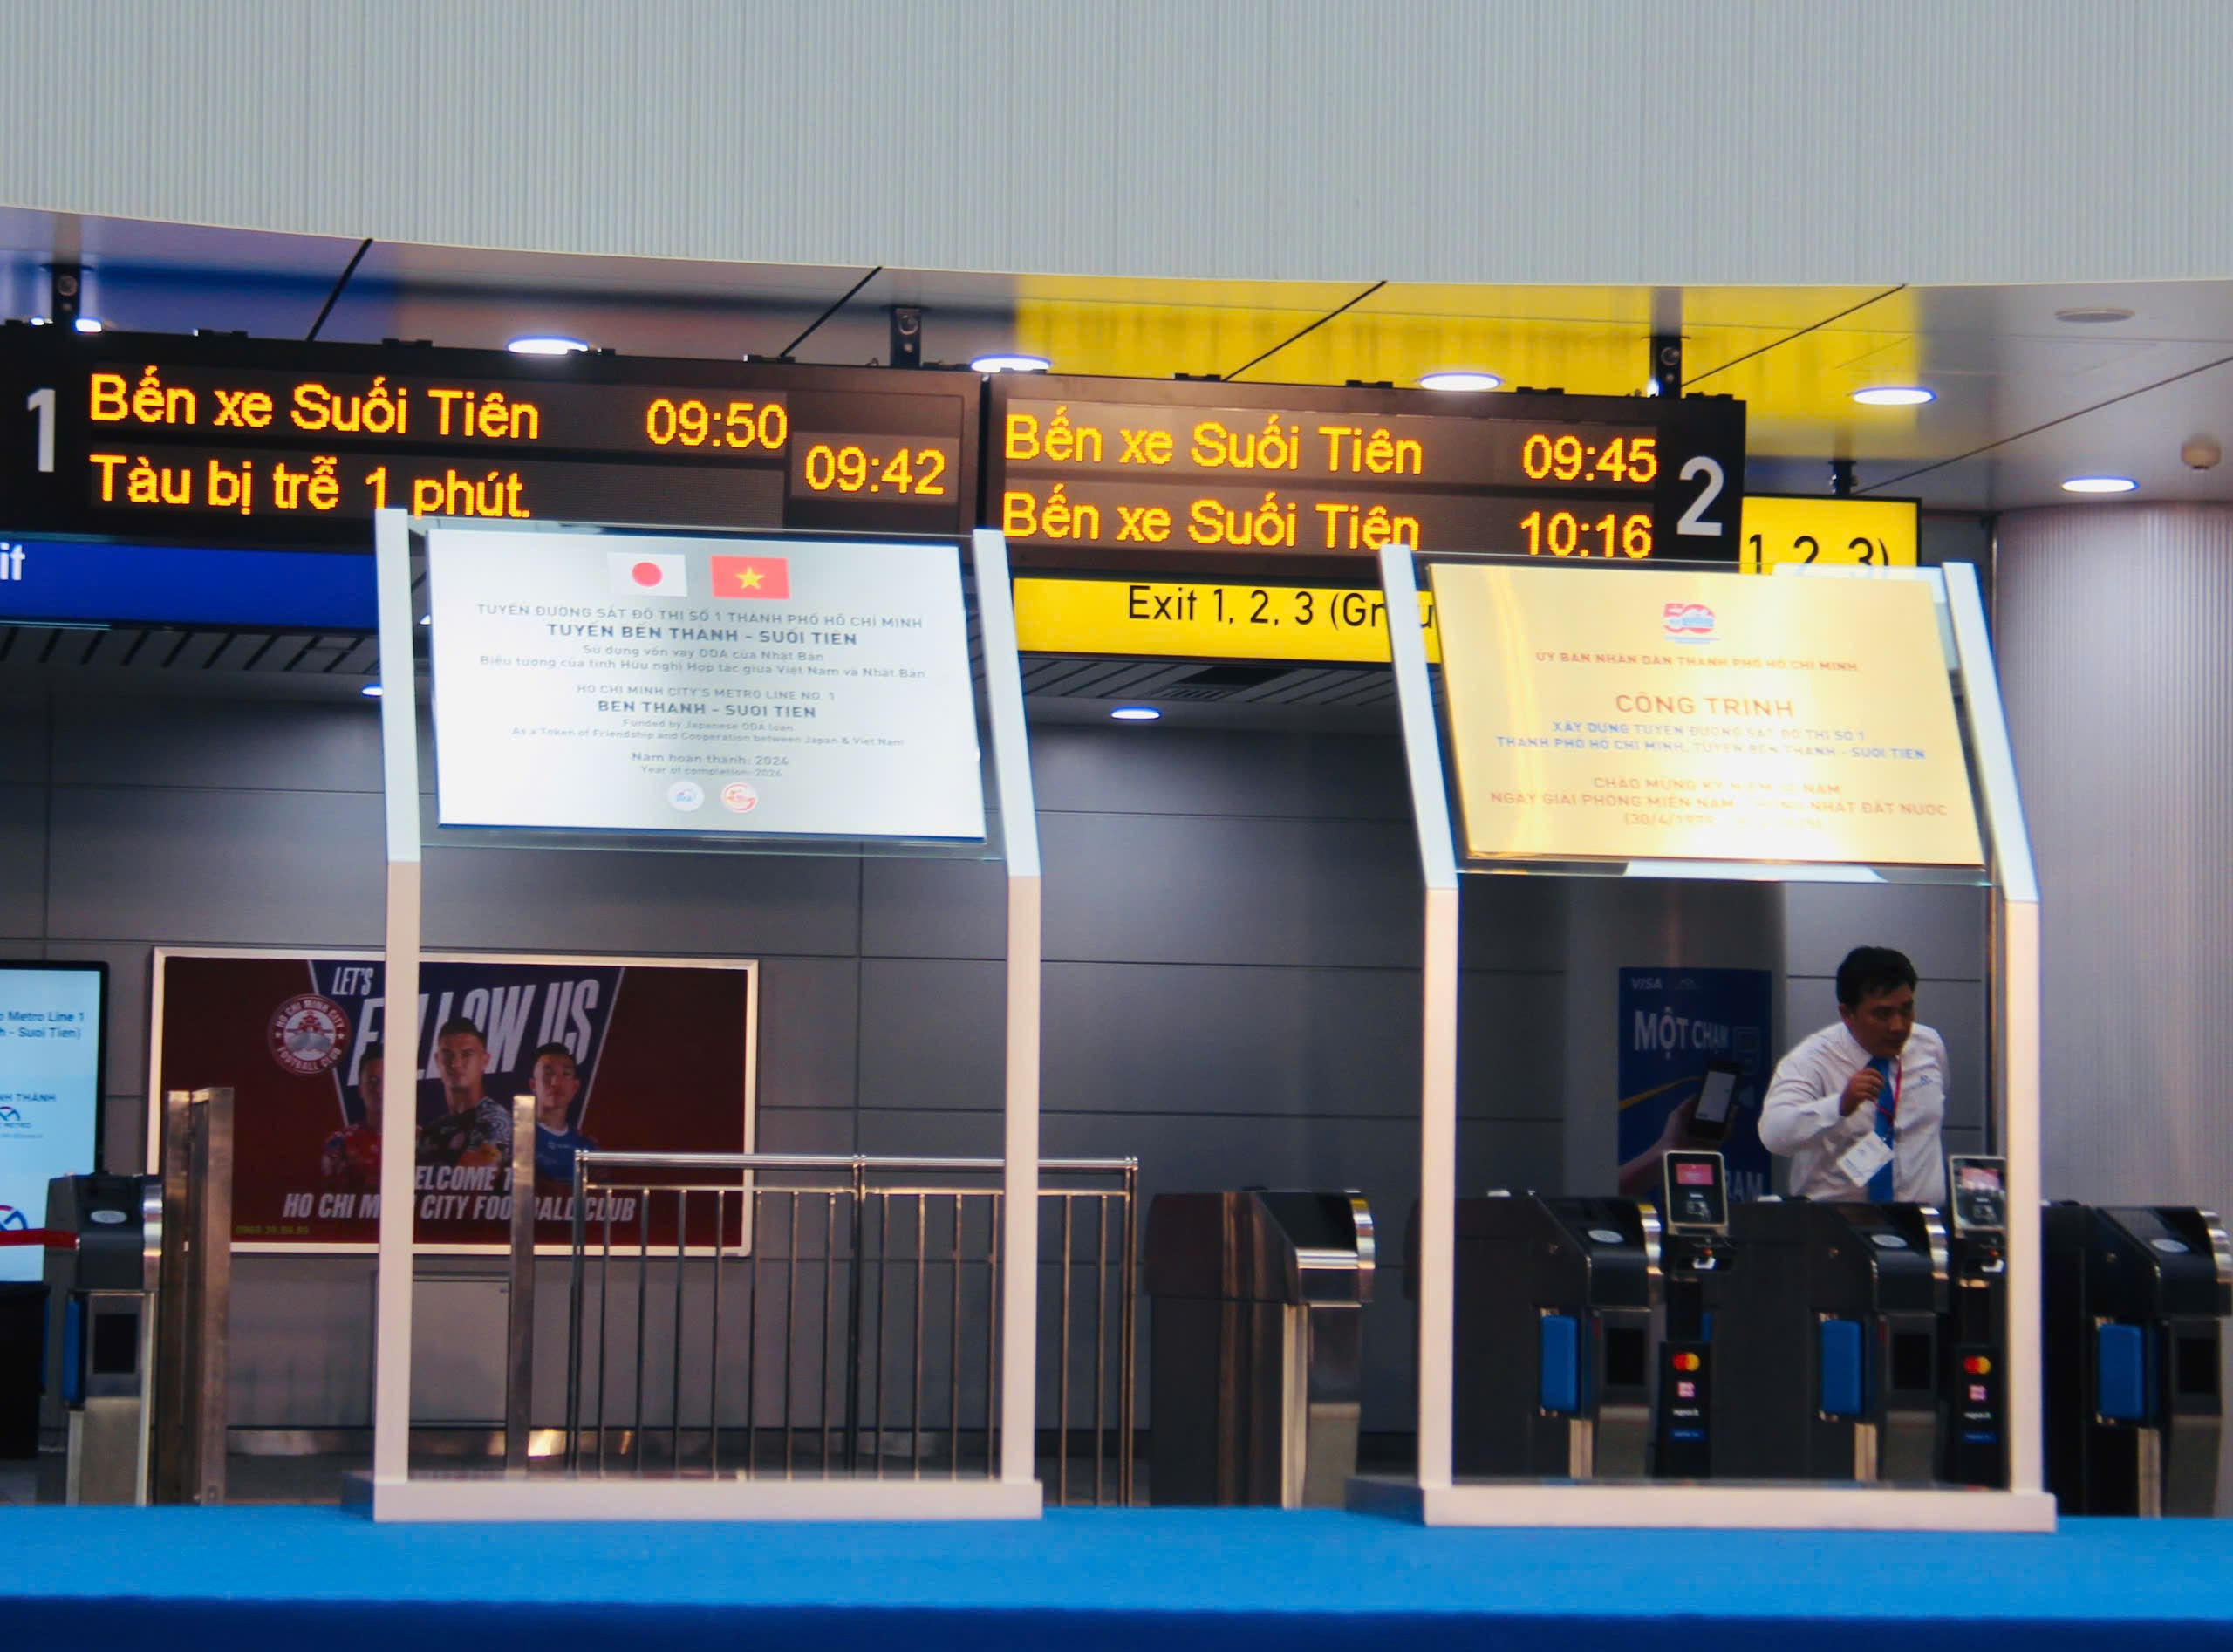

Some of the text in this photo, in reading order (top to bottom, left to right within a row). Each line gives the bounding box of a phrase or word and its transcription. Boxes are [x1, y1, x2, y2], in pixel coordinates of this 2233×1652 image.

[27, 389, 56, 472] 1
[90, 365, 788, 450] Bến xe Suối Tiên 09:50
[1006, 406, 1658, 483] Bến xe Suối Tiên 09:45
[90, 454, 531, 519] Tàu bị trễ 1 phút.
[805, 445, 945, 496] 09:42
[1676, 456, 1724, 536] 2
[1002, 483, 1652, 559] Bến xe Suối Tiên 10:16
[714, 612, 722, 622] 1
[881, 617, 923, 629] MINH
[1128, 585, 1198, 621] Exit
[1212, 589, 1233, 625] 1,
[1250, 590, 1279, 627] 2,
[1295, 591, 1314, 625] 3
[598, 700, 636, 713] BEN
[642, 701, 706, 715] THANH
[725, 704, 768, 717] SUOI
[775, 705, 816, 719] TIEN
[627, 686, 664, 696] MINH
[714, 688, 761, 699] METRO
[766, 690, 796, 700] LINE
[1615, 691, 1697, 714] CÔNG
[331, 967, 373, 995] LET'S
[1631, 978, 1663, 990] VISA
[346, 979, 599, 1086] FLLOW US
[1634, 1006, 1689, 1060] MỘT
[415, 1166, 497, 1191] ELCOME
[283, 1194, 311, 1219] HO
[318, 1194, 353, 1219] CHI
[420, 1195, 470, 1220] CITY
[584, 1198, 637, 1222] CLUB
